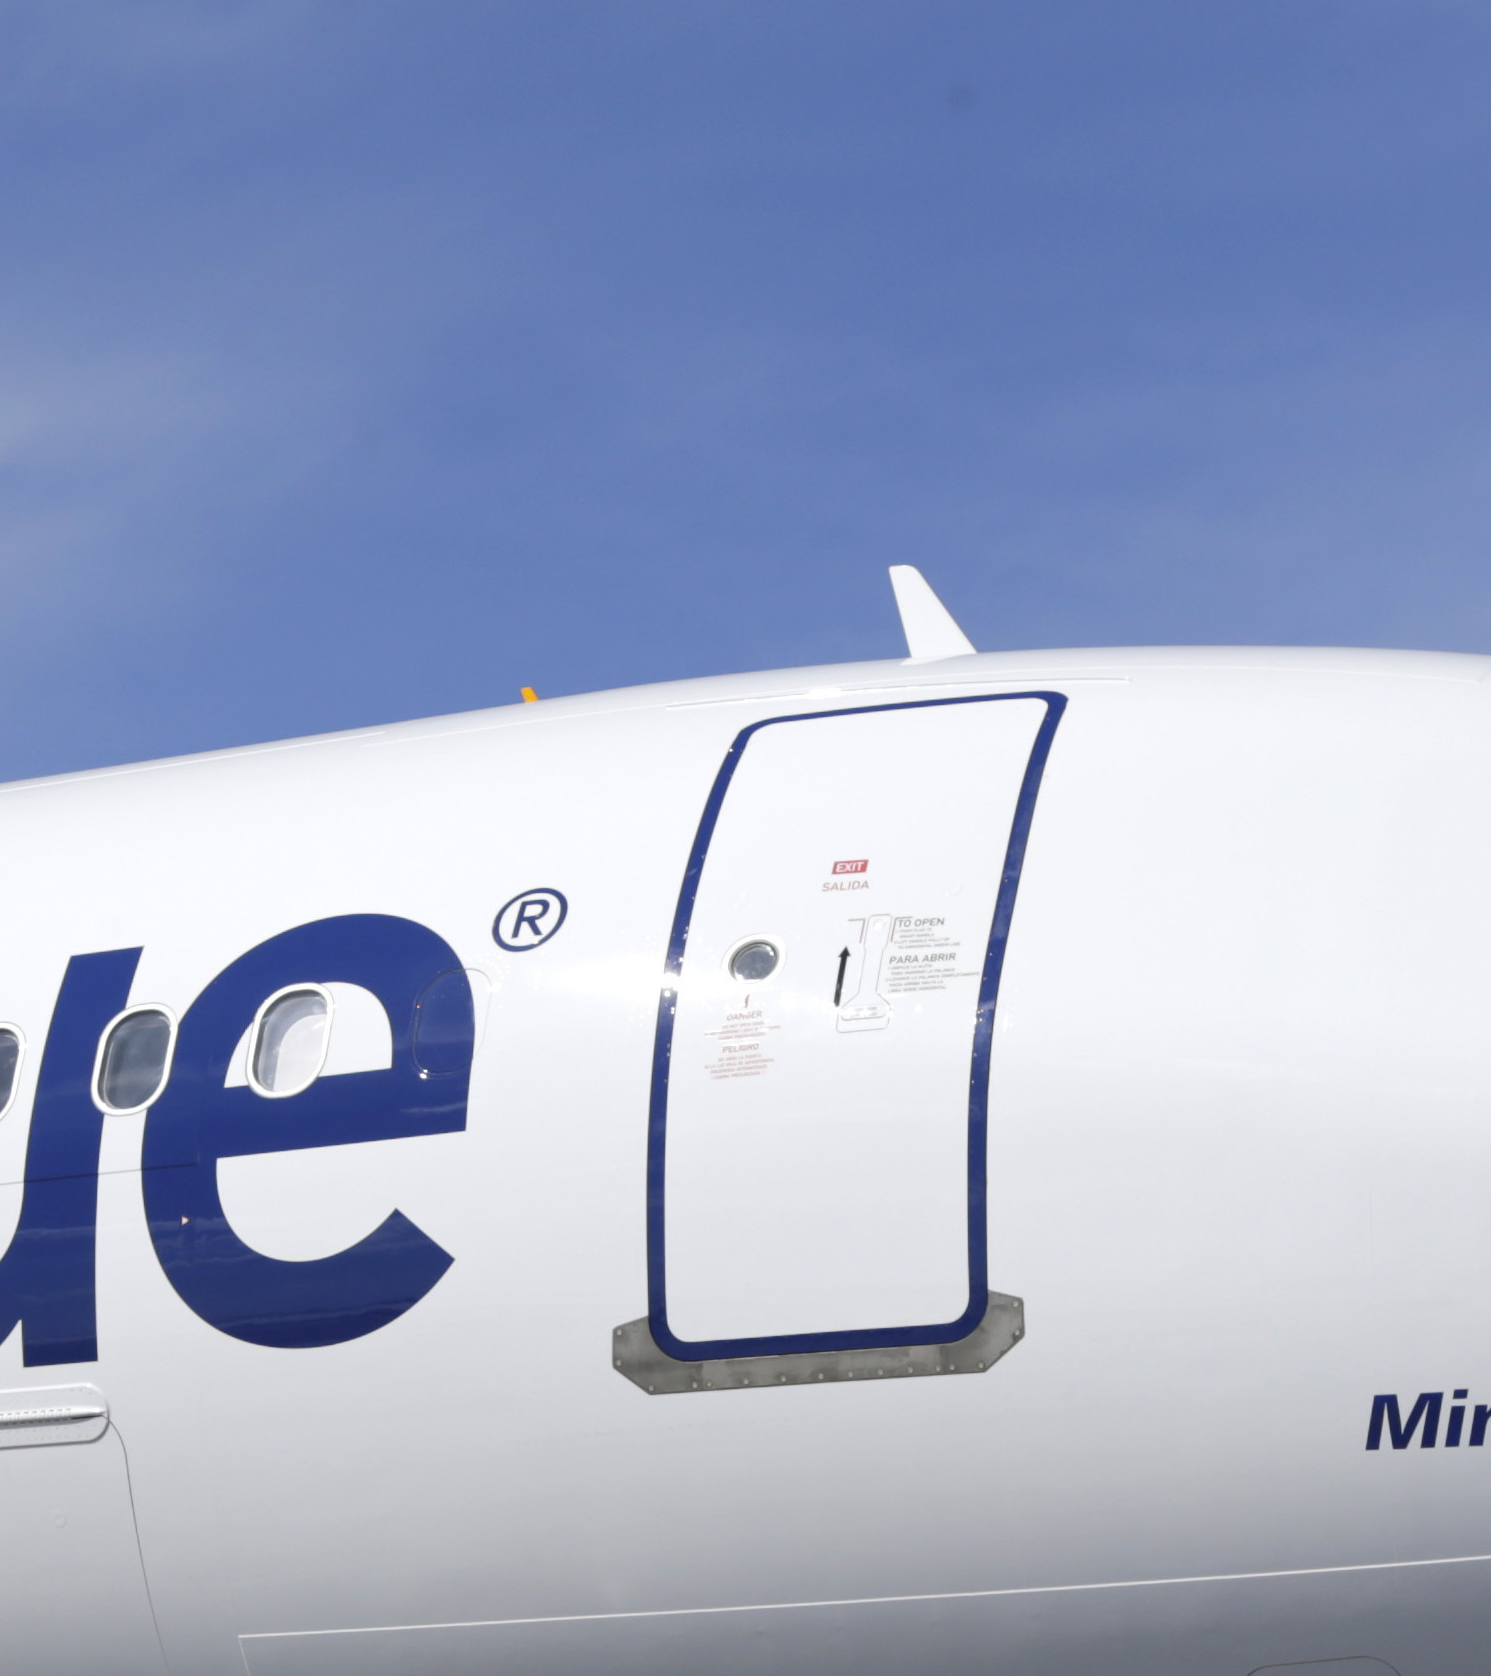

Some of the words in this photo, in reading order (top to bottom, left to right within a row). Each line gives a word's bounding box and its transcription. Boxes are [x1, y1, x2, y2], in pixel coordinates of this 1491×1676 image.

[835, 861, 866, 873] EXIT
[822, 880, 869, 892] SALIDA
[897, 919, 912, 928] TO
[914, 917, 946, 927] OPEN
[889, 955, 919, 964] PARA
[921, 952, 957, 963] ABRIR
